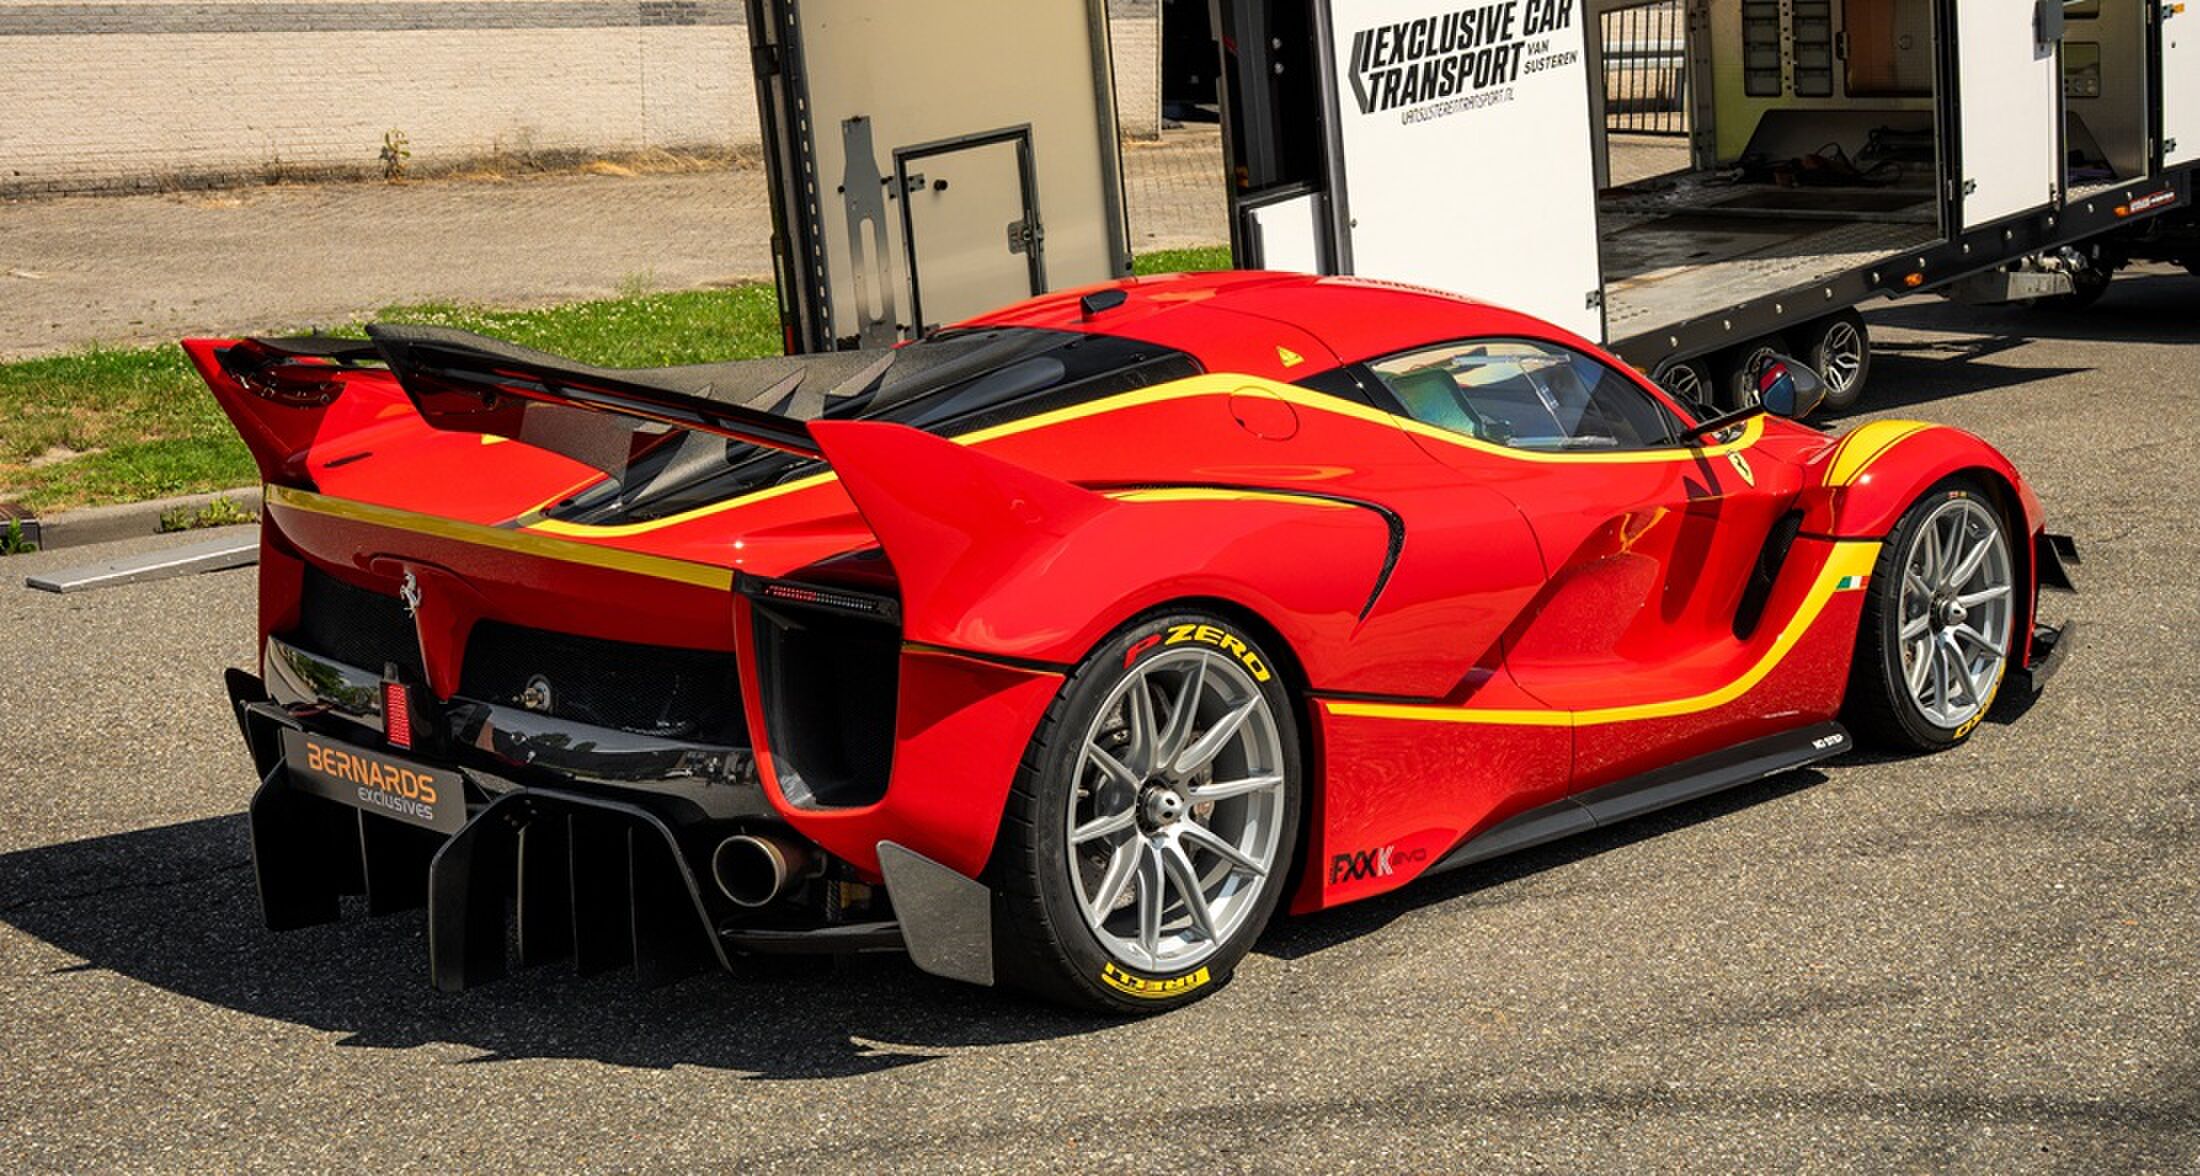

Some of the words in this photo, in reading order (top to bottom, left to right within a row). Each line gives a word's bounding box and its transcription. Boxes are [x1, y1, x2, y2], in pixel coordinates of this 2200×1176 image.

[1371, 2, 1517, 68] EXCLUSIVE
[1523, 0, 1573, 36] CAR
[1523, 51, 1578, 74] SUSTEREN
[1527, 40, 1549, 55] VAN
[1367, 41, 1525, 113] TRANSPORT
[1123, 633, 1163, 670] P
[1164, 623, 1271, 683] ZERO
[306, 742, 437, 804] BERNARDS
[357, 786, 434, 820] exclusives
